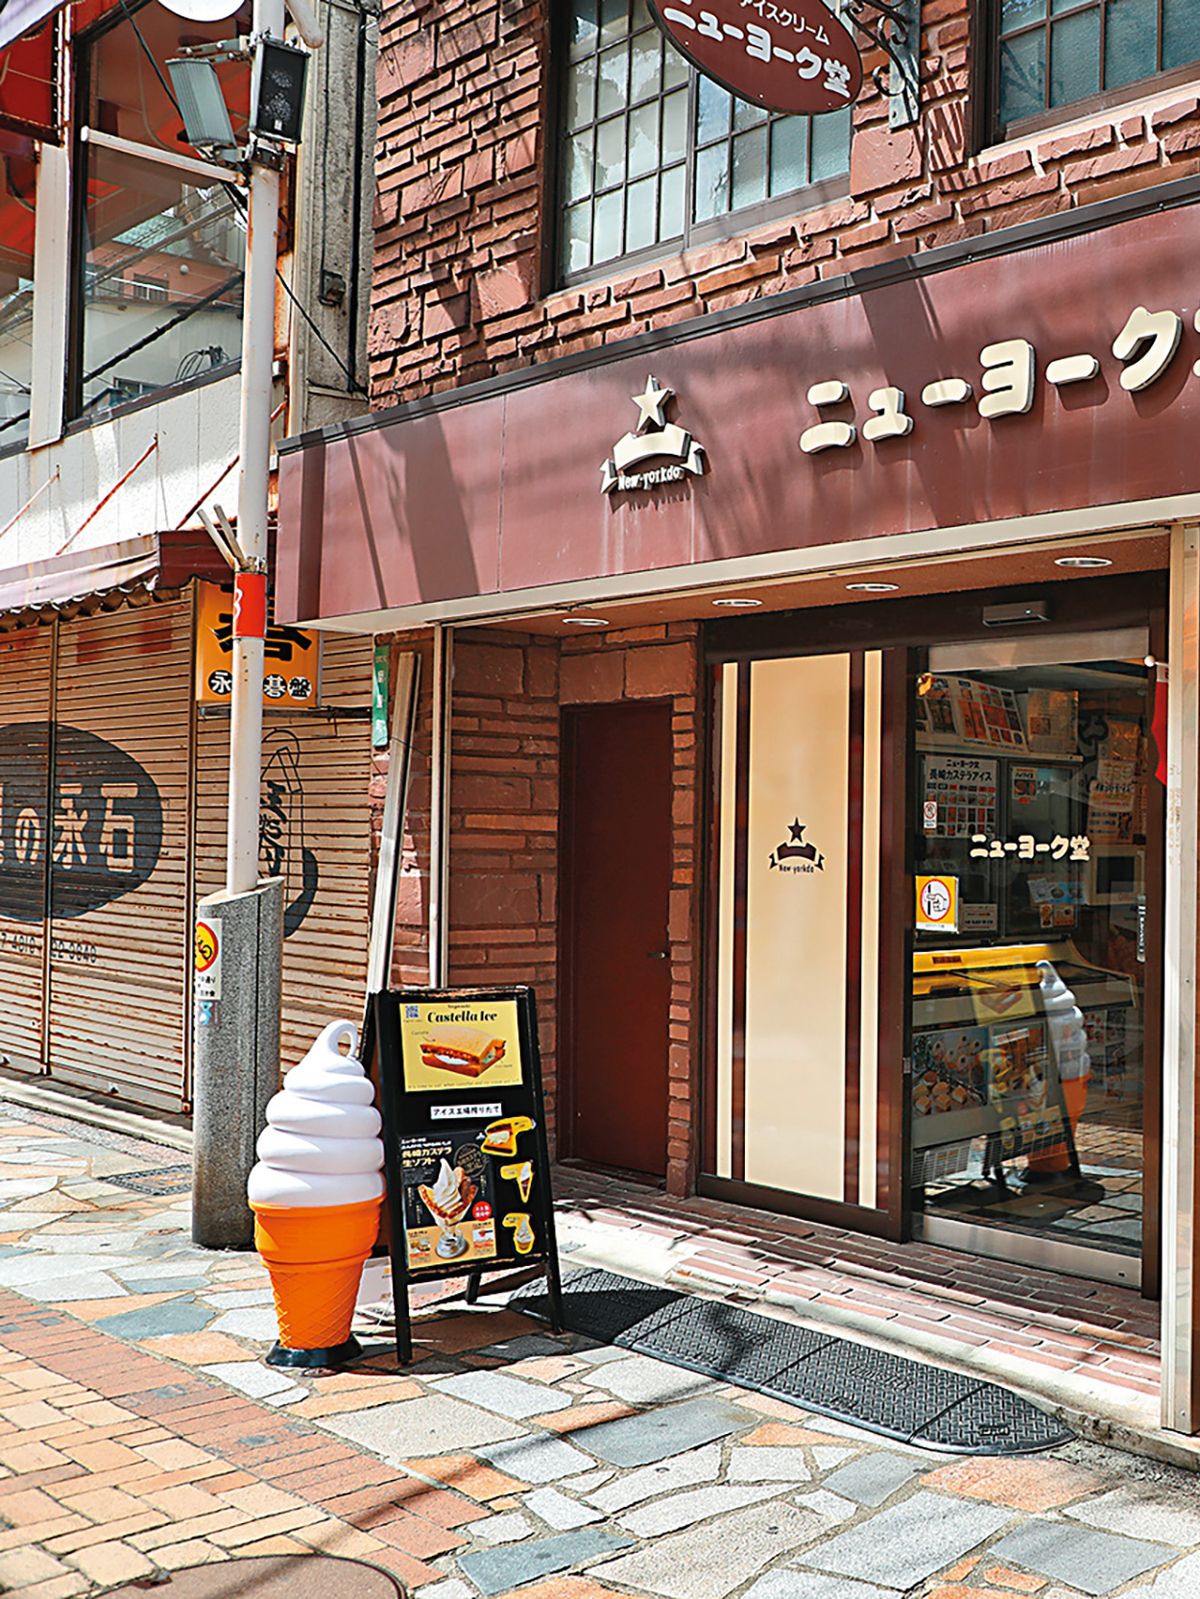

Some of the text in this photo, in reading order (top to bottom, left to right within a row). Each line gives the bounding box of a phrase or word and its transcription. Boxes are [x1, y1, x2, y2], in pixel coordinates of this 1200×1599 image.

[663, 0, 851, 98] ニューヨーク堂
[0, 782, 139, 873] の永石
[970, 833, 1090, 861] ニューヨーク堂
[427, 1010, 497, 1022] Castella Ice
